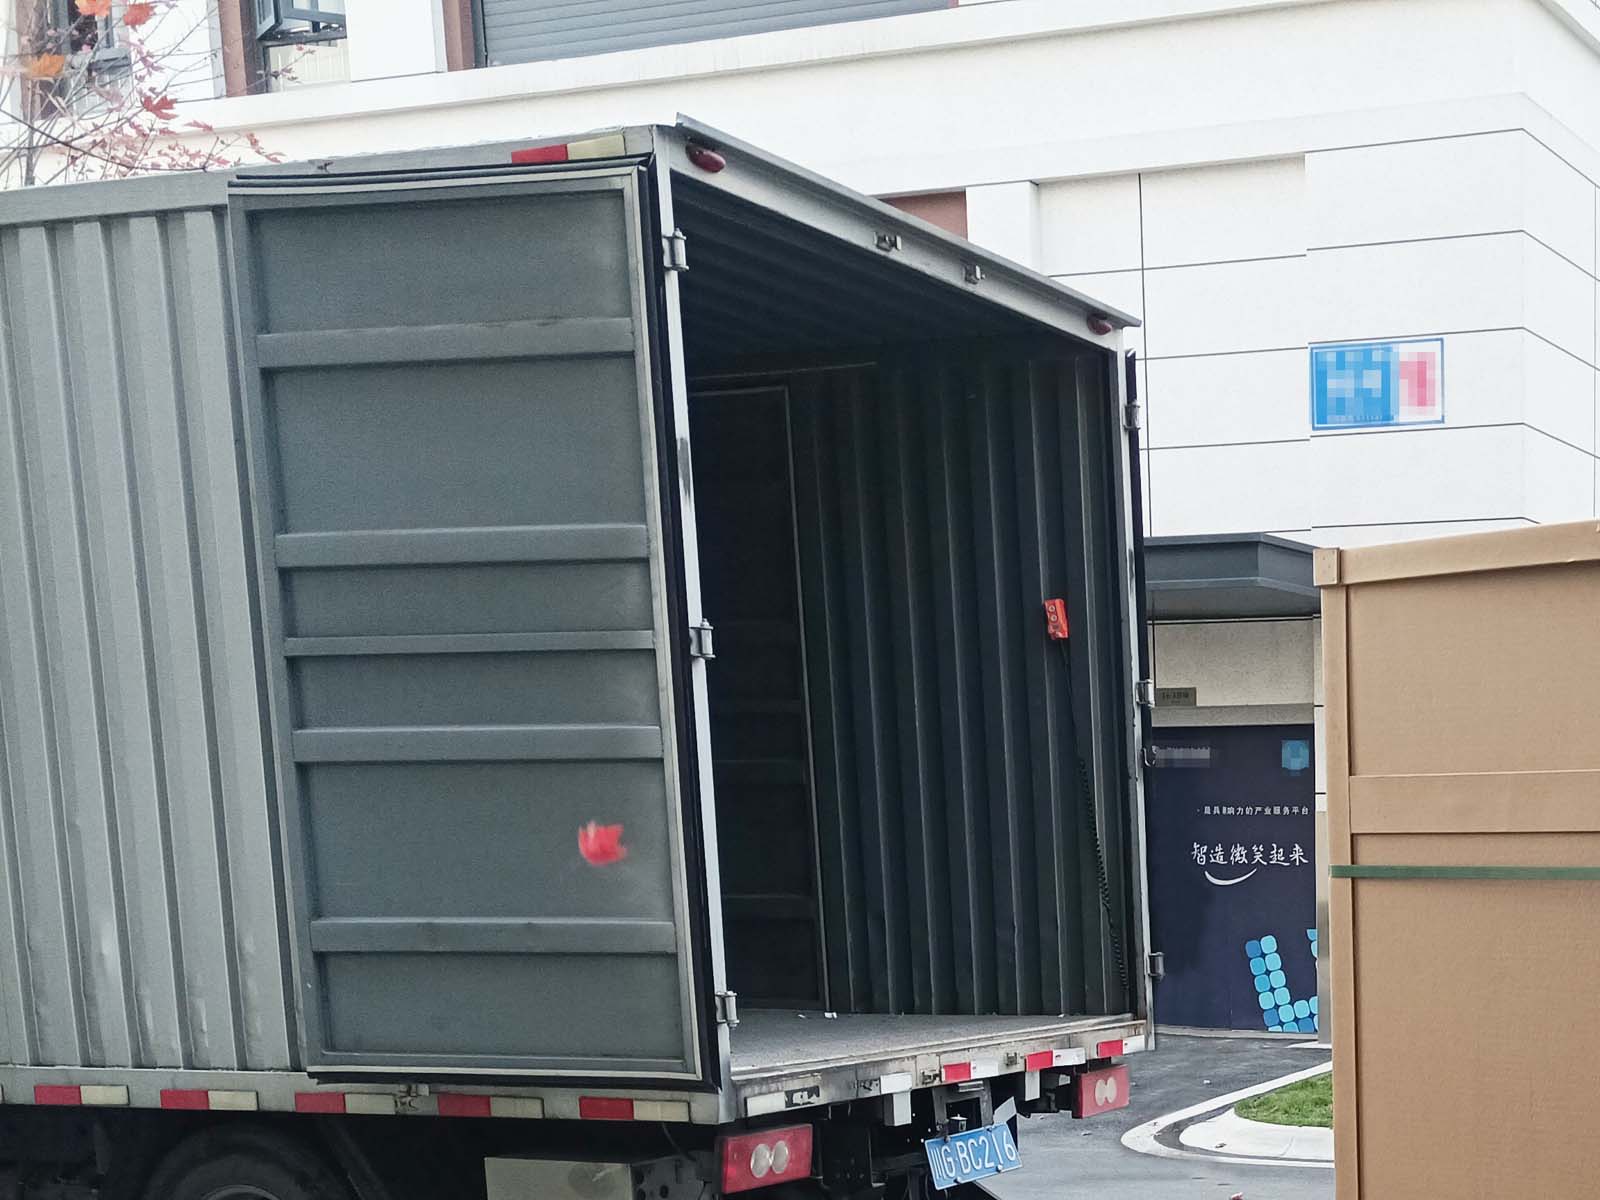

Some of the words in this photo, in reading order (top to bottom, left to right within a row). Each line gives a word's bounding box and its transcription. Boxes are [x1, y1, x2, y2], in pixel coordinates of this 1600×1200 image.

[1191, 841, 1309, 866] 智造微笑起来
